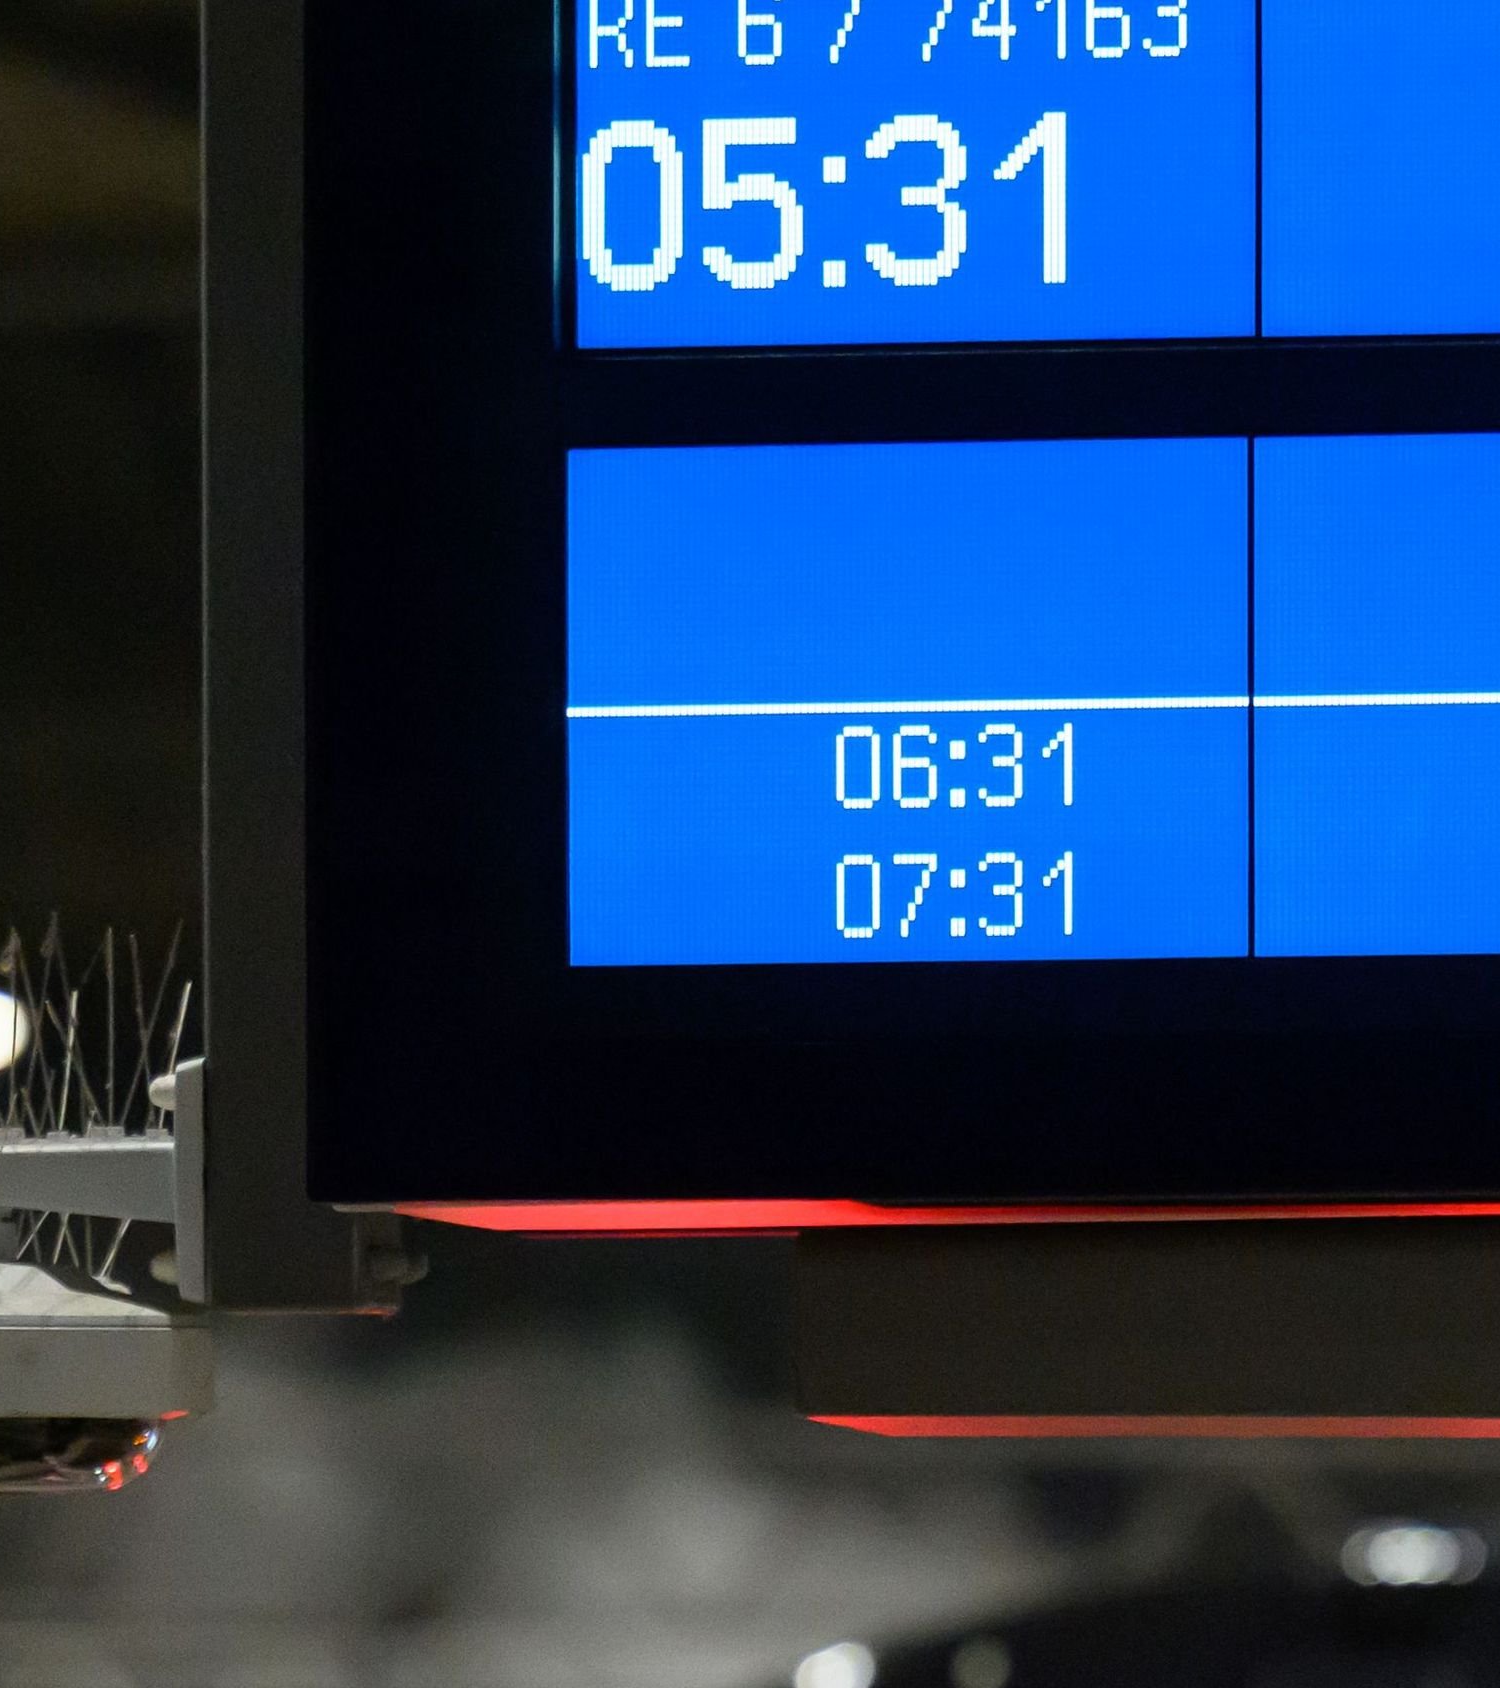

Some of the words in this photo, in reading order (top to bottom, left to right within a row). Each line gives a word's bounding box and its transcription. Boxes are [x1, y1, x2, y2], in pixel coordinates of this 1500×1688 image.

[589, 0, 691, 68] RE
[737, 0, 782, 65] 6
[583, 112, 1067, 292] 05:31
[835, 722, 1073, 809] 06:31
[836, 851, 1073, 939] 07:31
